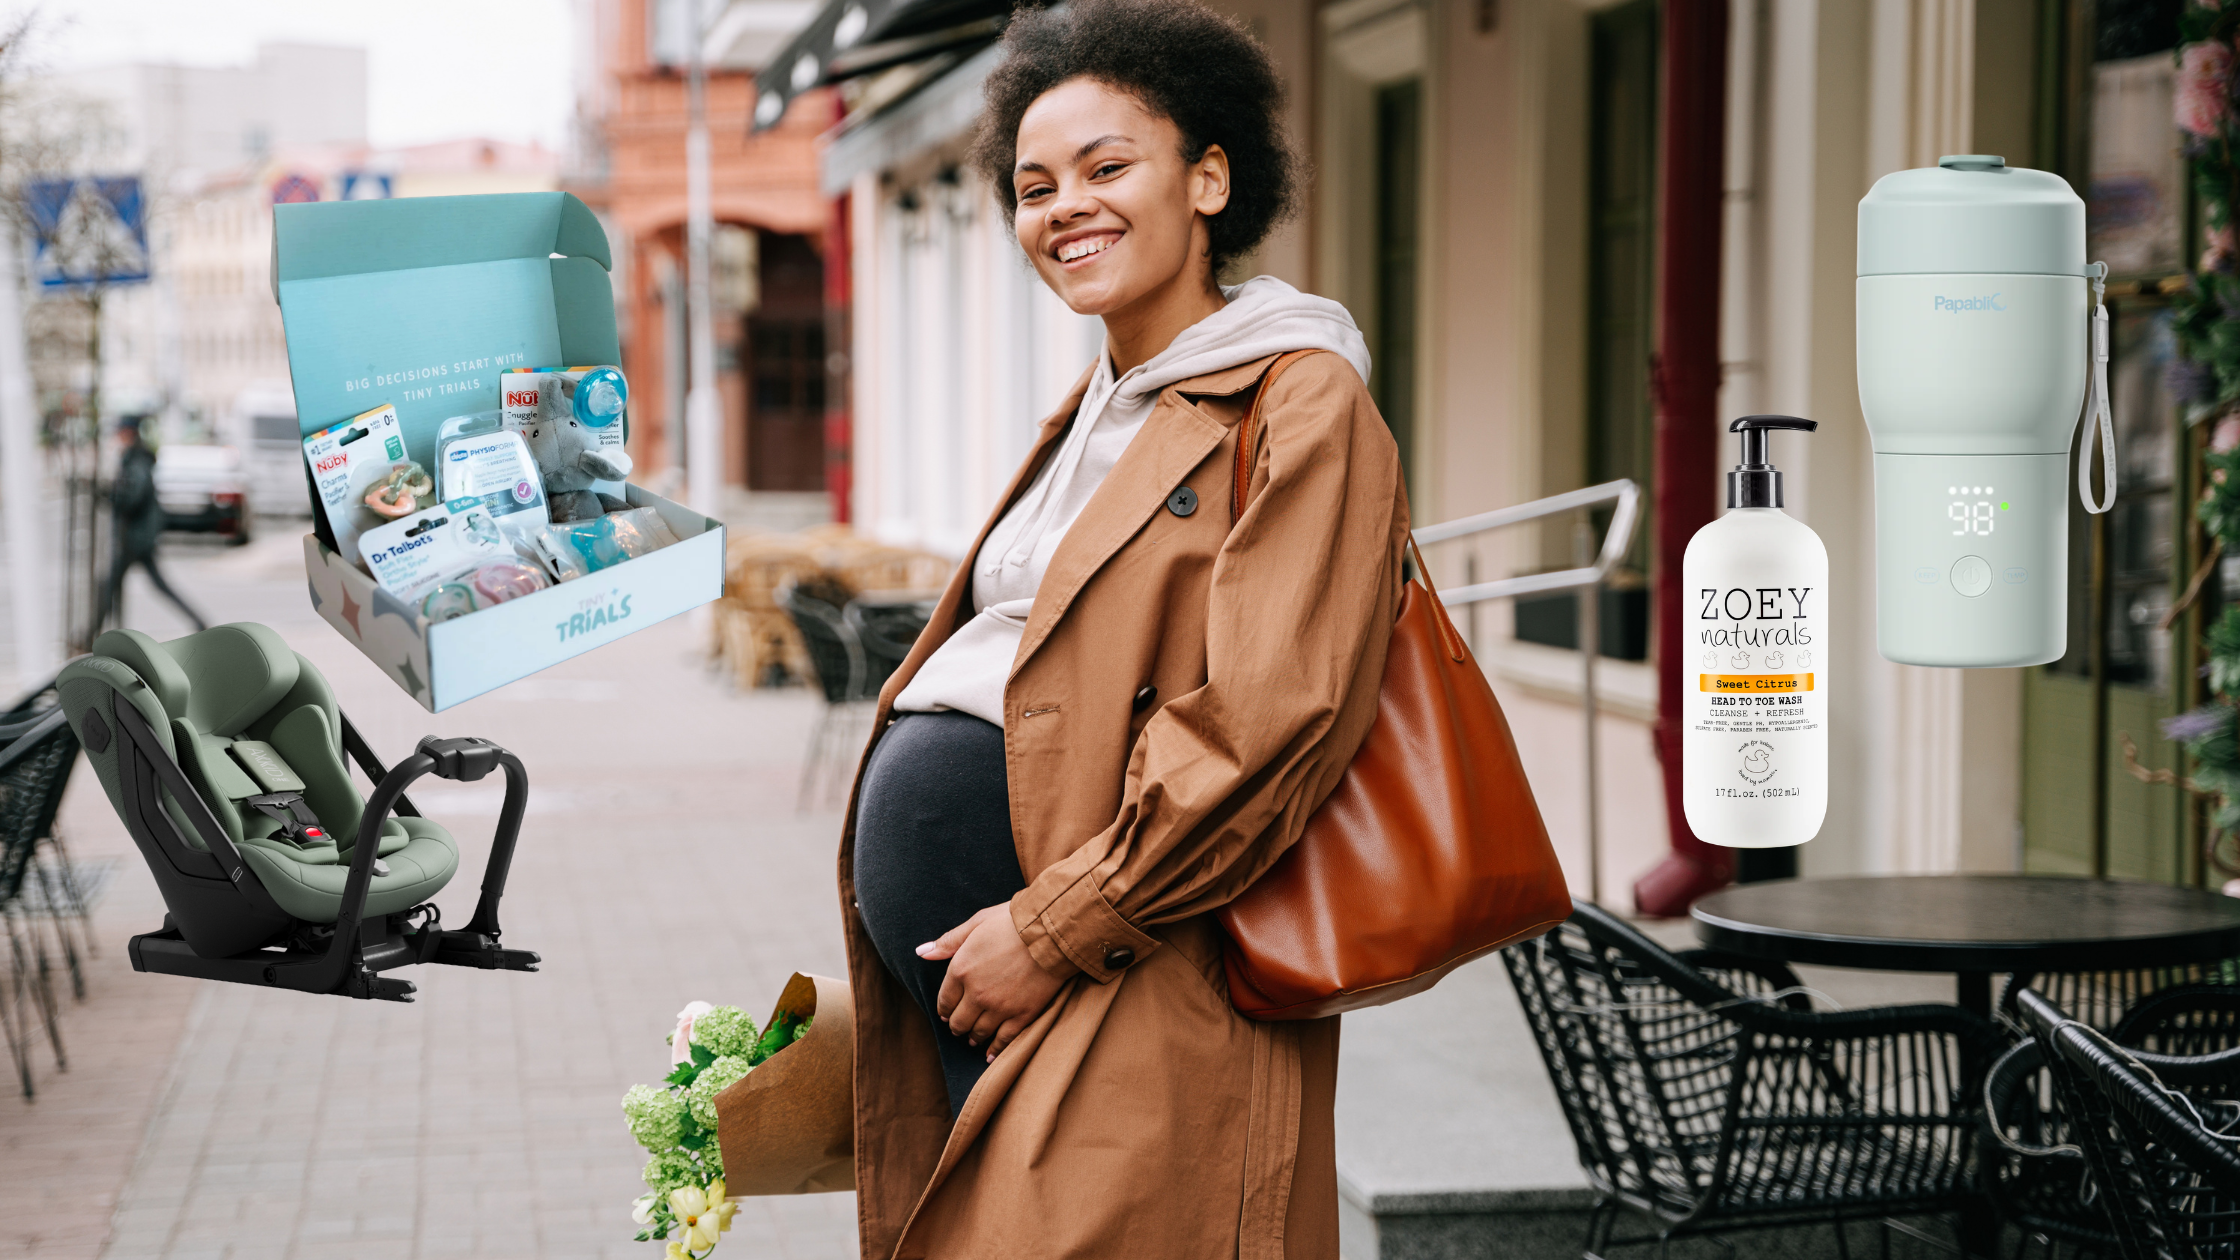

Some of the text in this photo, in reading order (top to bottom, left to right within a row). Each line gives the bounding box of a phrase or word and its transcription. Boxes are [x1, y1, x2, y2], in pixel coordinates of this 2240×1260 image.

[345, 352, 525, 392] BIG DECISIONS START WITH
[403, 378, 481, 402] TINY TRIALS
[490, 456, 517, 466] BREATHING
[321, 473, 348, 490] Charms
[324, 485, 344, 499] Pacifier
[453, 498, 475, 509] 0-6m
[1948, 501, 1994, 536] 98
[371, 534, 434, 564] Dr Talbot's
[377, 555, 414, 572] Soft Flex
[577, 592, 606, 611] TINY
[1700, 588, 1811, 621] ZOEY
[1701, 621, 1812, 649] naturals
[1716, 679, 1798, 689] Sweet Citrus
[1711, 696, 1803, 706] HEAD TO TOE WASH
[1709, 709, 1749, 718] CLEANSE
[1766, 708, 1804, 717] REFRESH
